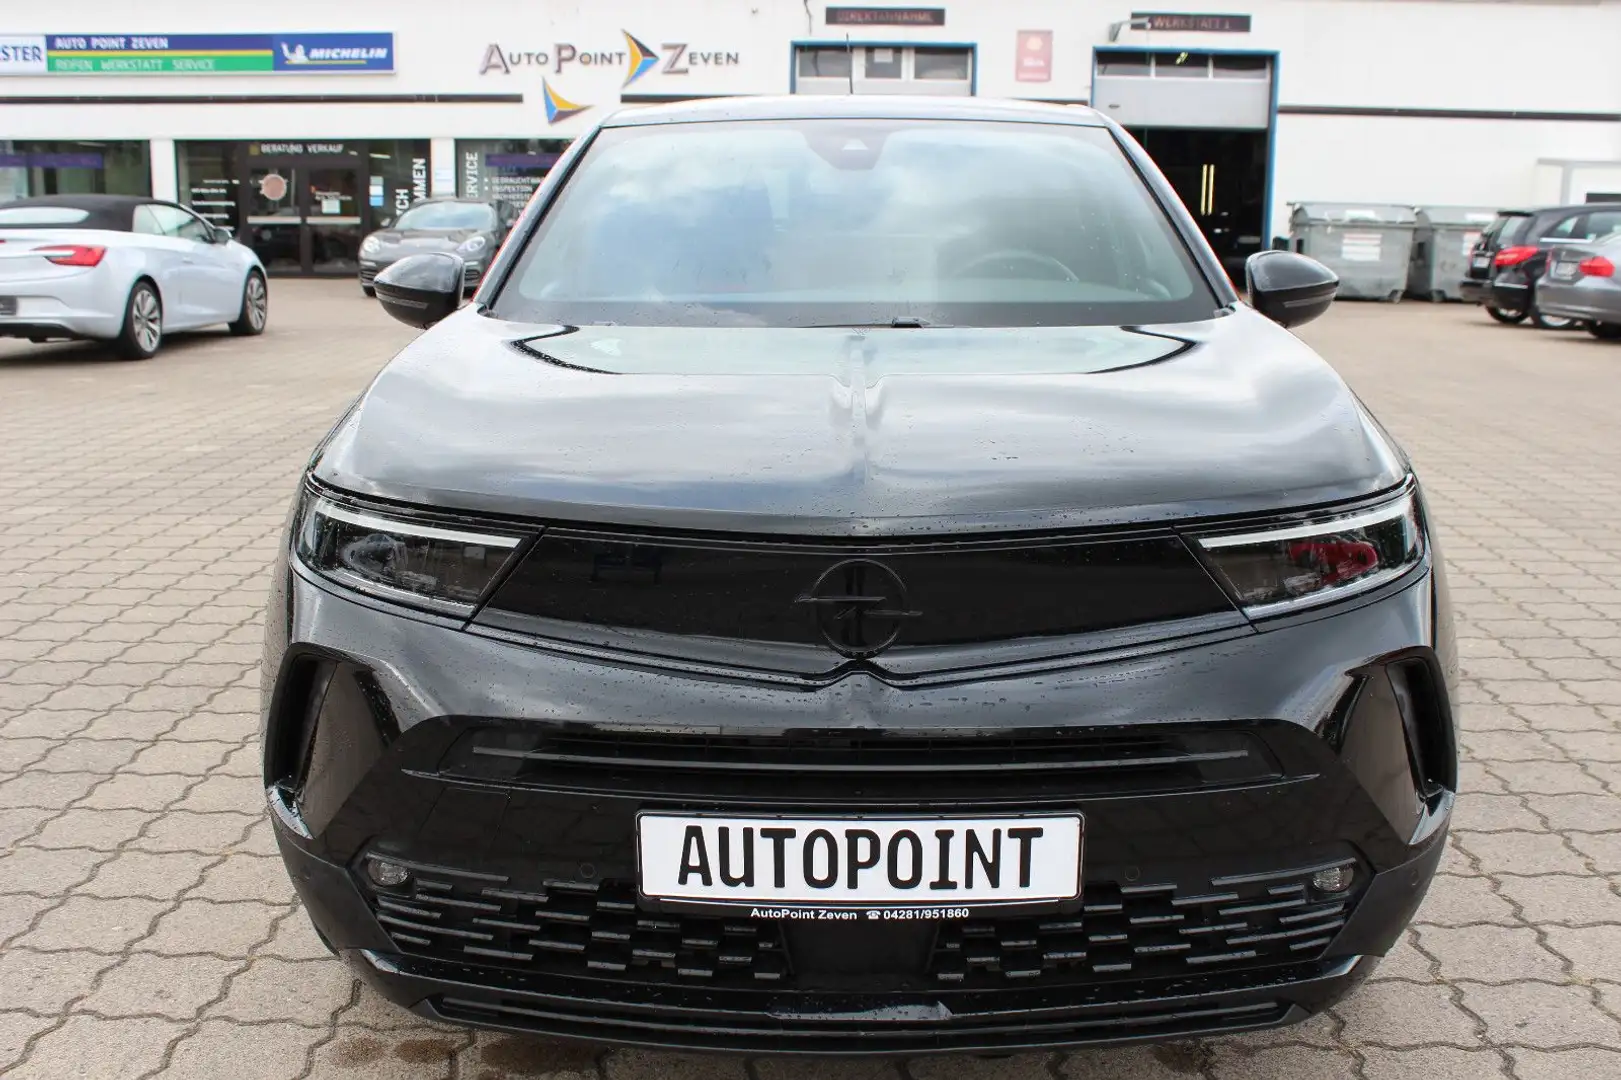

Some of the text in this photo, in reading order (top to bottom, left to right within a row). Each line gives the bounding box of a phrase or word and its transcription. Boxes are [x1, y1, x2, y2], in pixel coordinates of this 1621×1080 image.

[55, 37, 169, 49] AUTO POINT ZEVEN
[0, 46, 42, 61] STER
[309, 48, 388, 60] MICHELIN
[100, 59, 162, 71] WERKSTATT
[172, 59, 215, 70] SERVICE
[306, 143, 344, 153] VERKAUF
[678, 825, 1044, 890] AUTOPOINT
[750, 907, 969, 920] AutoPoint Zeven 04281/951860
